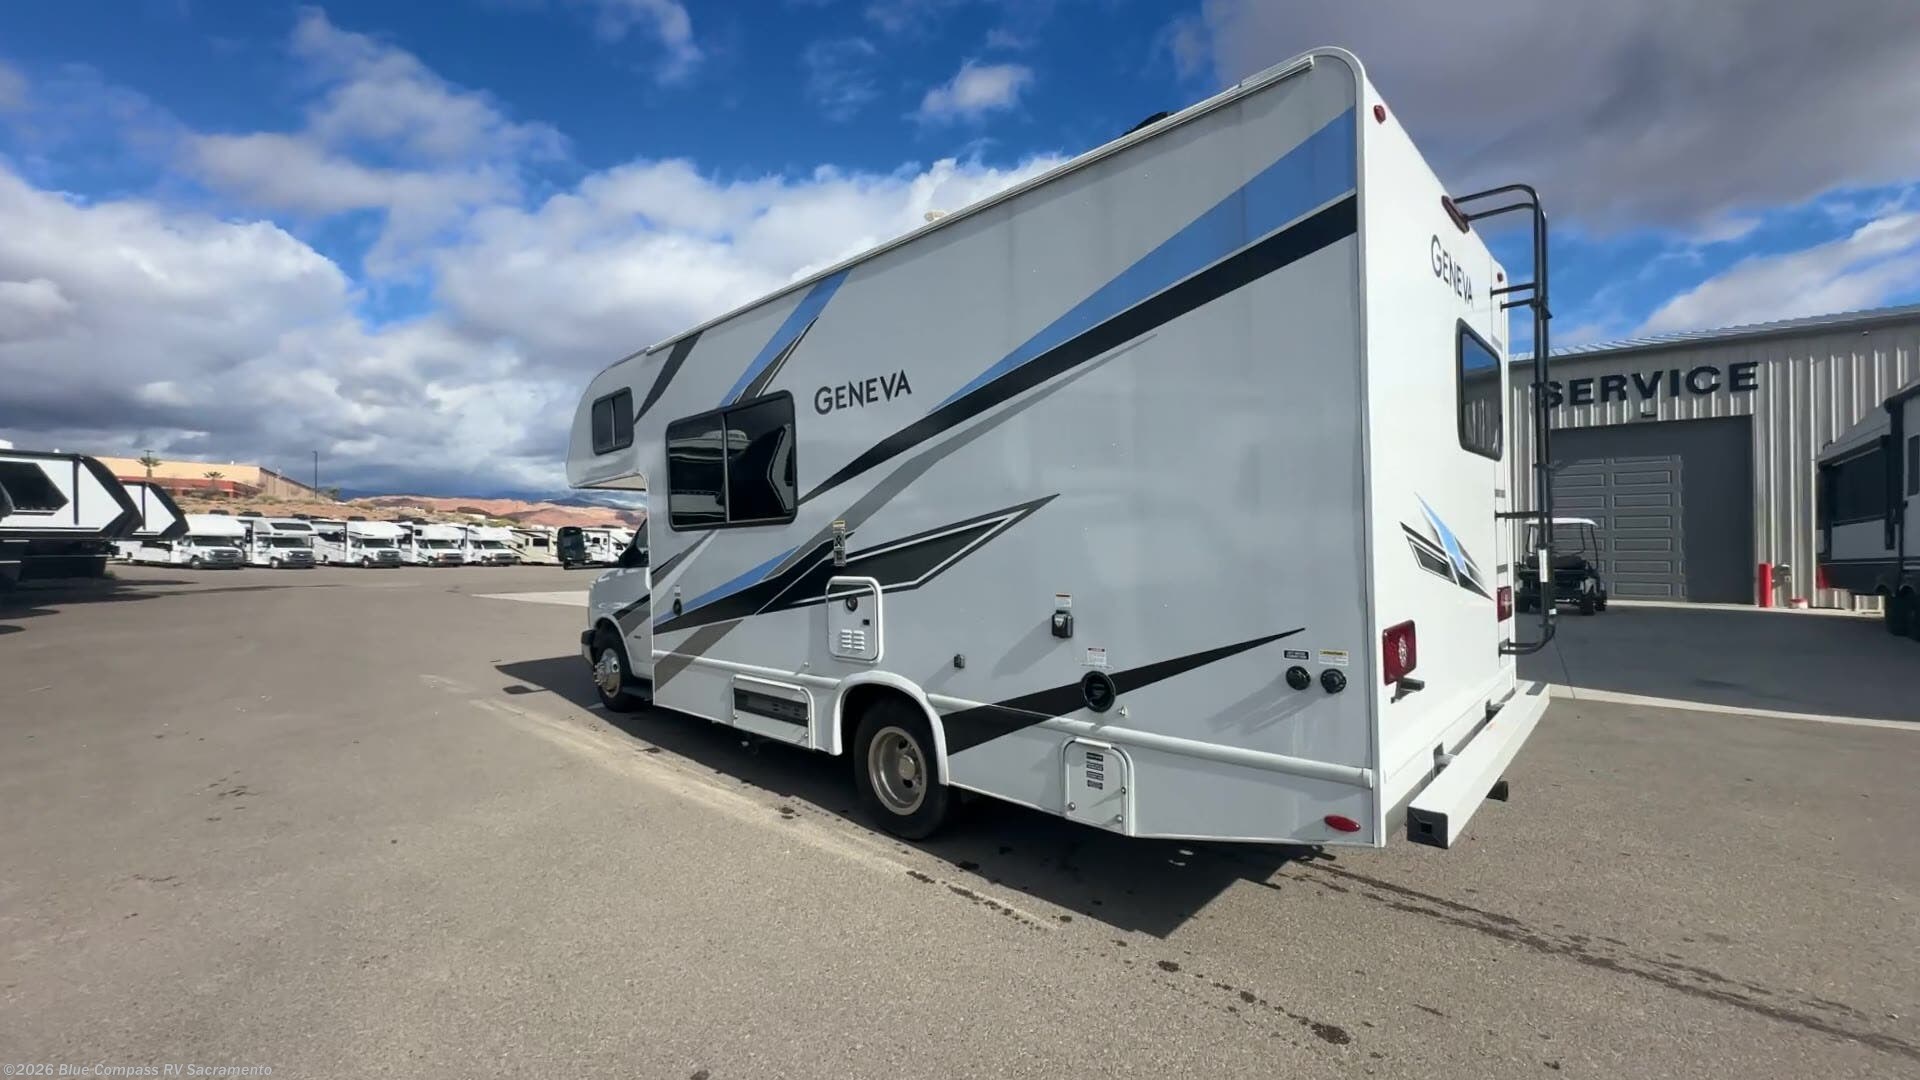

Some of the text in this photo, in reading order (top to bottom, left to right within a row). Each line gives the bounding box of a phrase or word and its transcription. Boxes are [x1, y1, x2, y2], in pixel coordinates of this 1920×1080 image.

[1430, 234, 1474, 306] GENEVA
[814, 369, 912, 415] GENEVA
[1541, 361, 1759, 408] SERVICE
